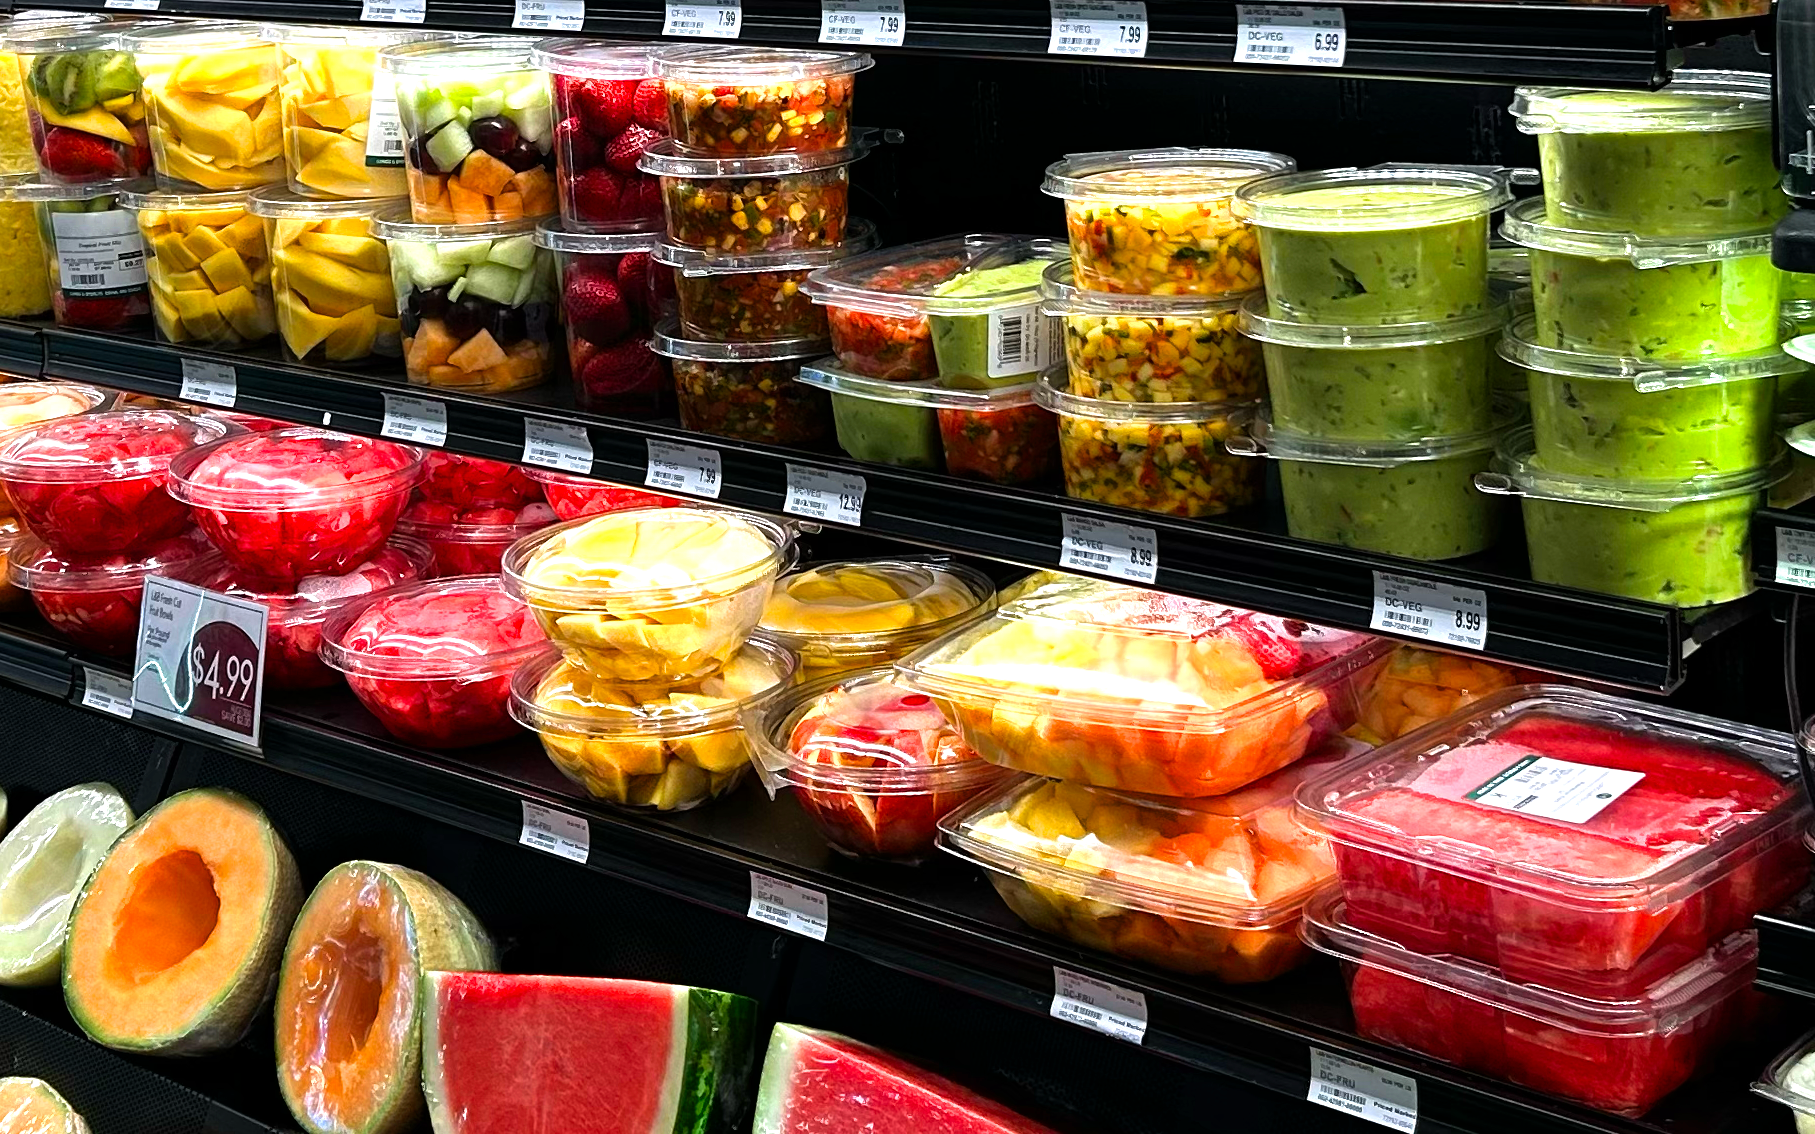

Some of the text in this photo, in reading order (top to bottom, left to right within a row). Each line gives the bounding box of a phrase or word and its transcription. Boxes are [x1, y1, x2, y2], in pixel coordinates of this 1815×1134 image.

[671, 9, 696, 18] CF-VEG
[718, 10, 736, 26] 7.99
[828, 15, 855, 24] CF-VEG
[880, 16, 898, 33] 7.99
[1059, 24, 1091, 33] CF-VEG
[1119, 25, 1141, 43] 7.99
[1248, 31, 1283, 41] DC-VEG
[1314, 32, 1339, 51] 6.99
[699, 467, 715, 484] 7.99
[839, 493, 861, 512] 12.99
[1071, 536, 1103, 550] DC-VEG
[1130, 547, 1152, 566] 8.99
[1787, 552, 1815, 565] CF-V
[1385, 596, 1422, 612] DC-VEG
[1455, 610, 1480, 630] 8.99
[192, 642, 254, 702] $4.99
[1063, 988, 1094, 1004] DC-FRU
[1320, 1069, 1356, 1089] DC-FRU
[1374, 1101, 1393, 1113] Priced
